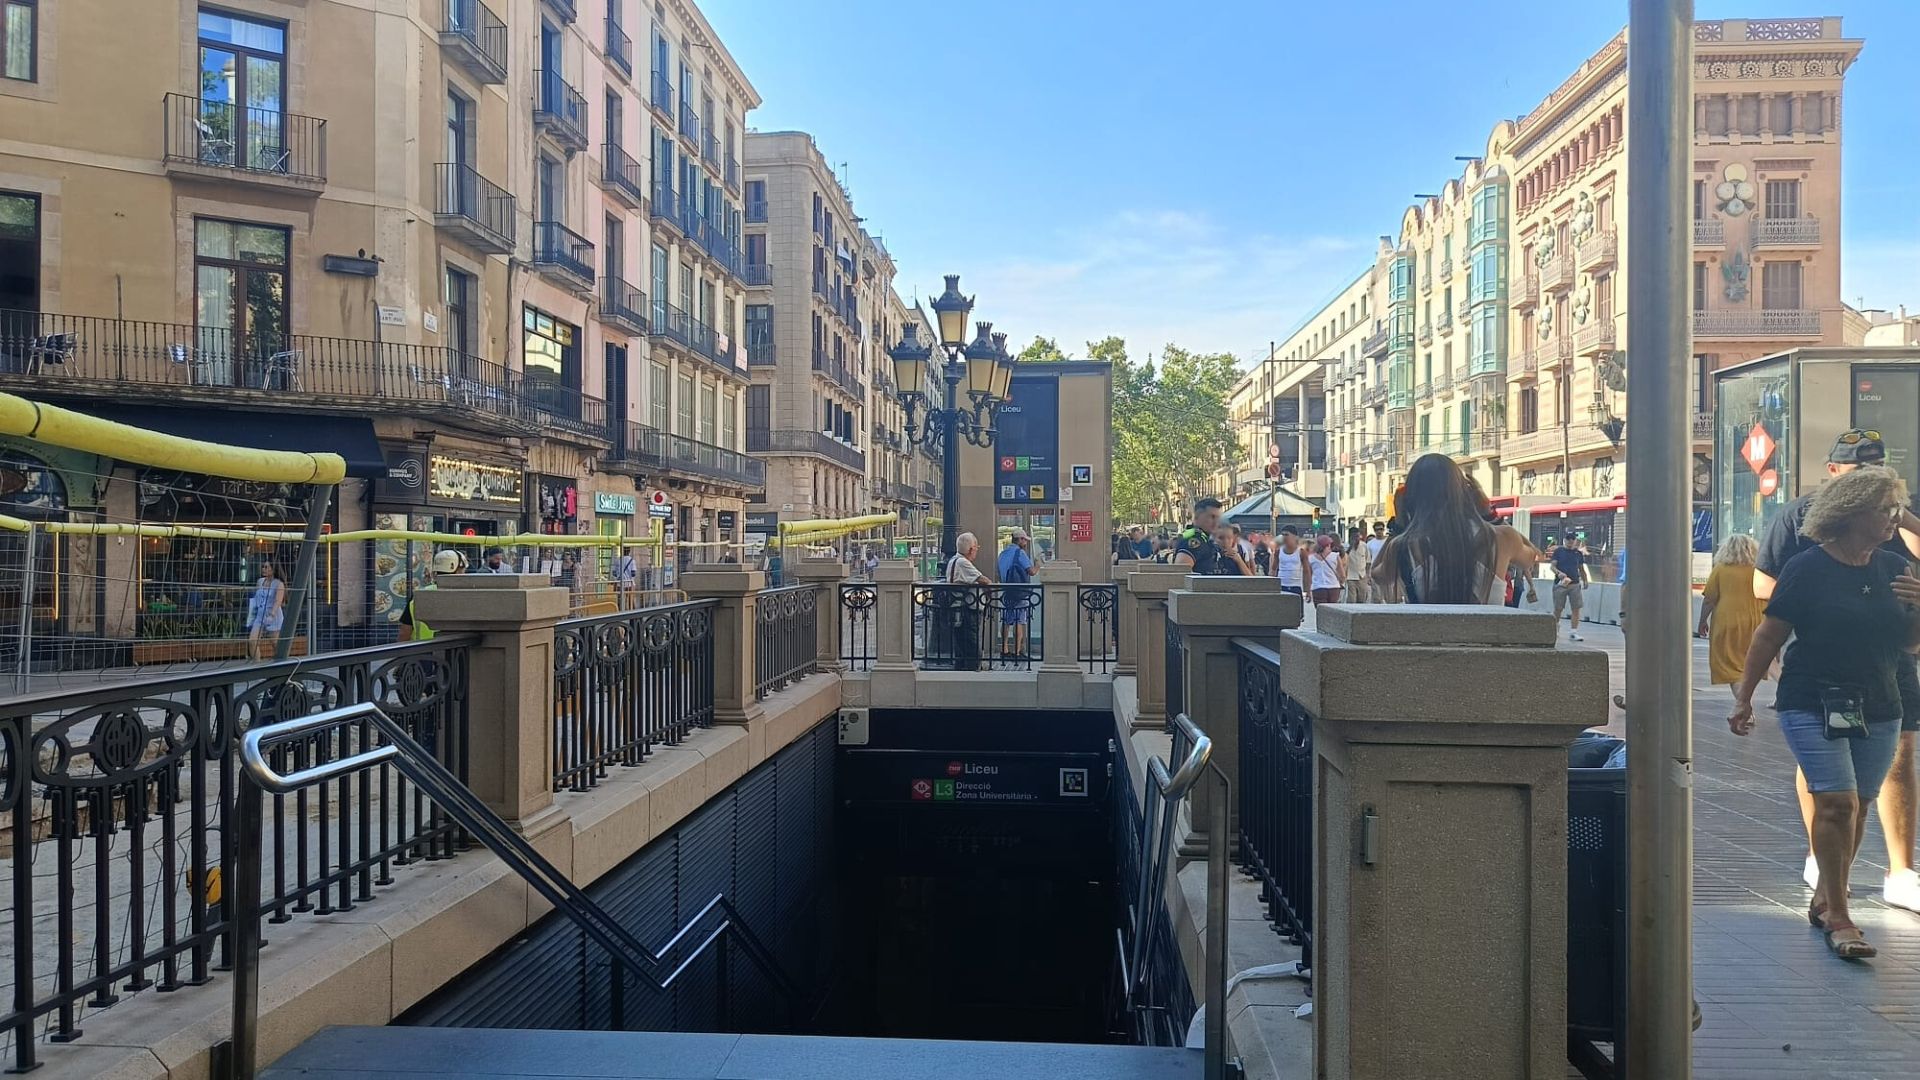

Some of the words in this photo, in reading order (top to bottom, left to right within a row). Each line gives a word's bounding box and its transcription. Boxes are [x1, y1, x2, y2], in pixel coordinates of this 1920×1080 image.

[1859, 393, 1882, 401] Liceu
[1000, 404, 1021, 413] Liceu
[1750, 435, 1765, 461] M
[964, 763, 999, 775] Liceu
[935, 782, 953, 796] L3
[956, 781, 991, 790] Direcció
[956, 791, 977, 799] Zona
